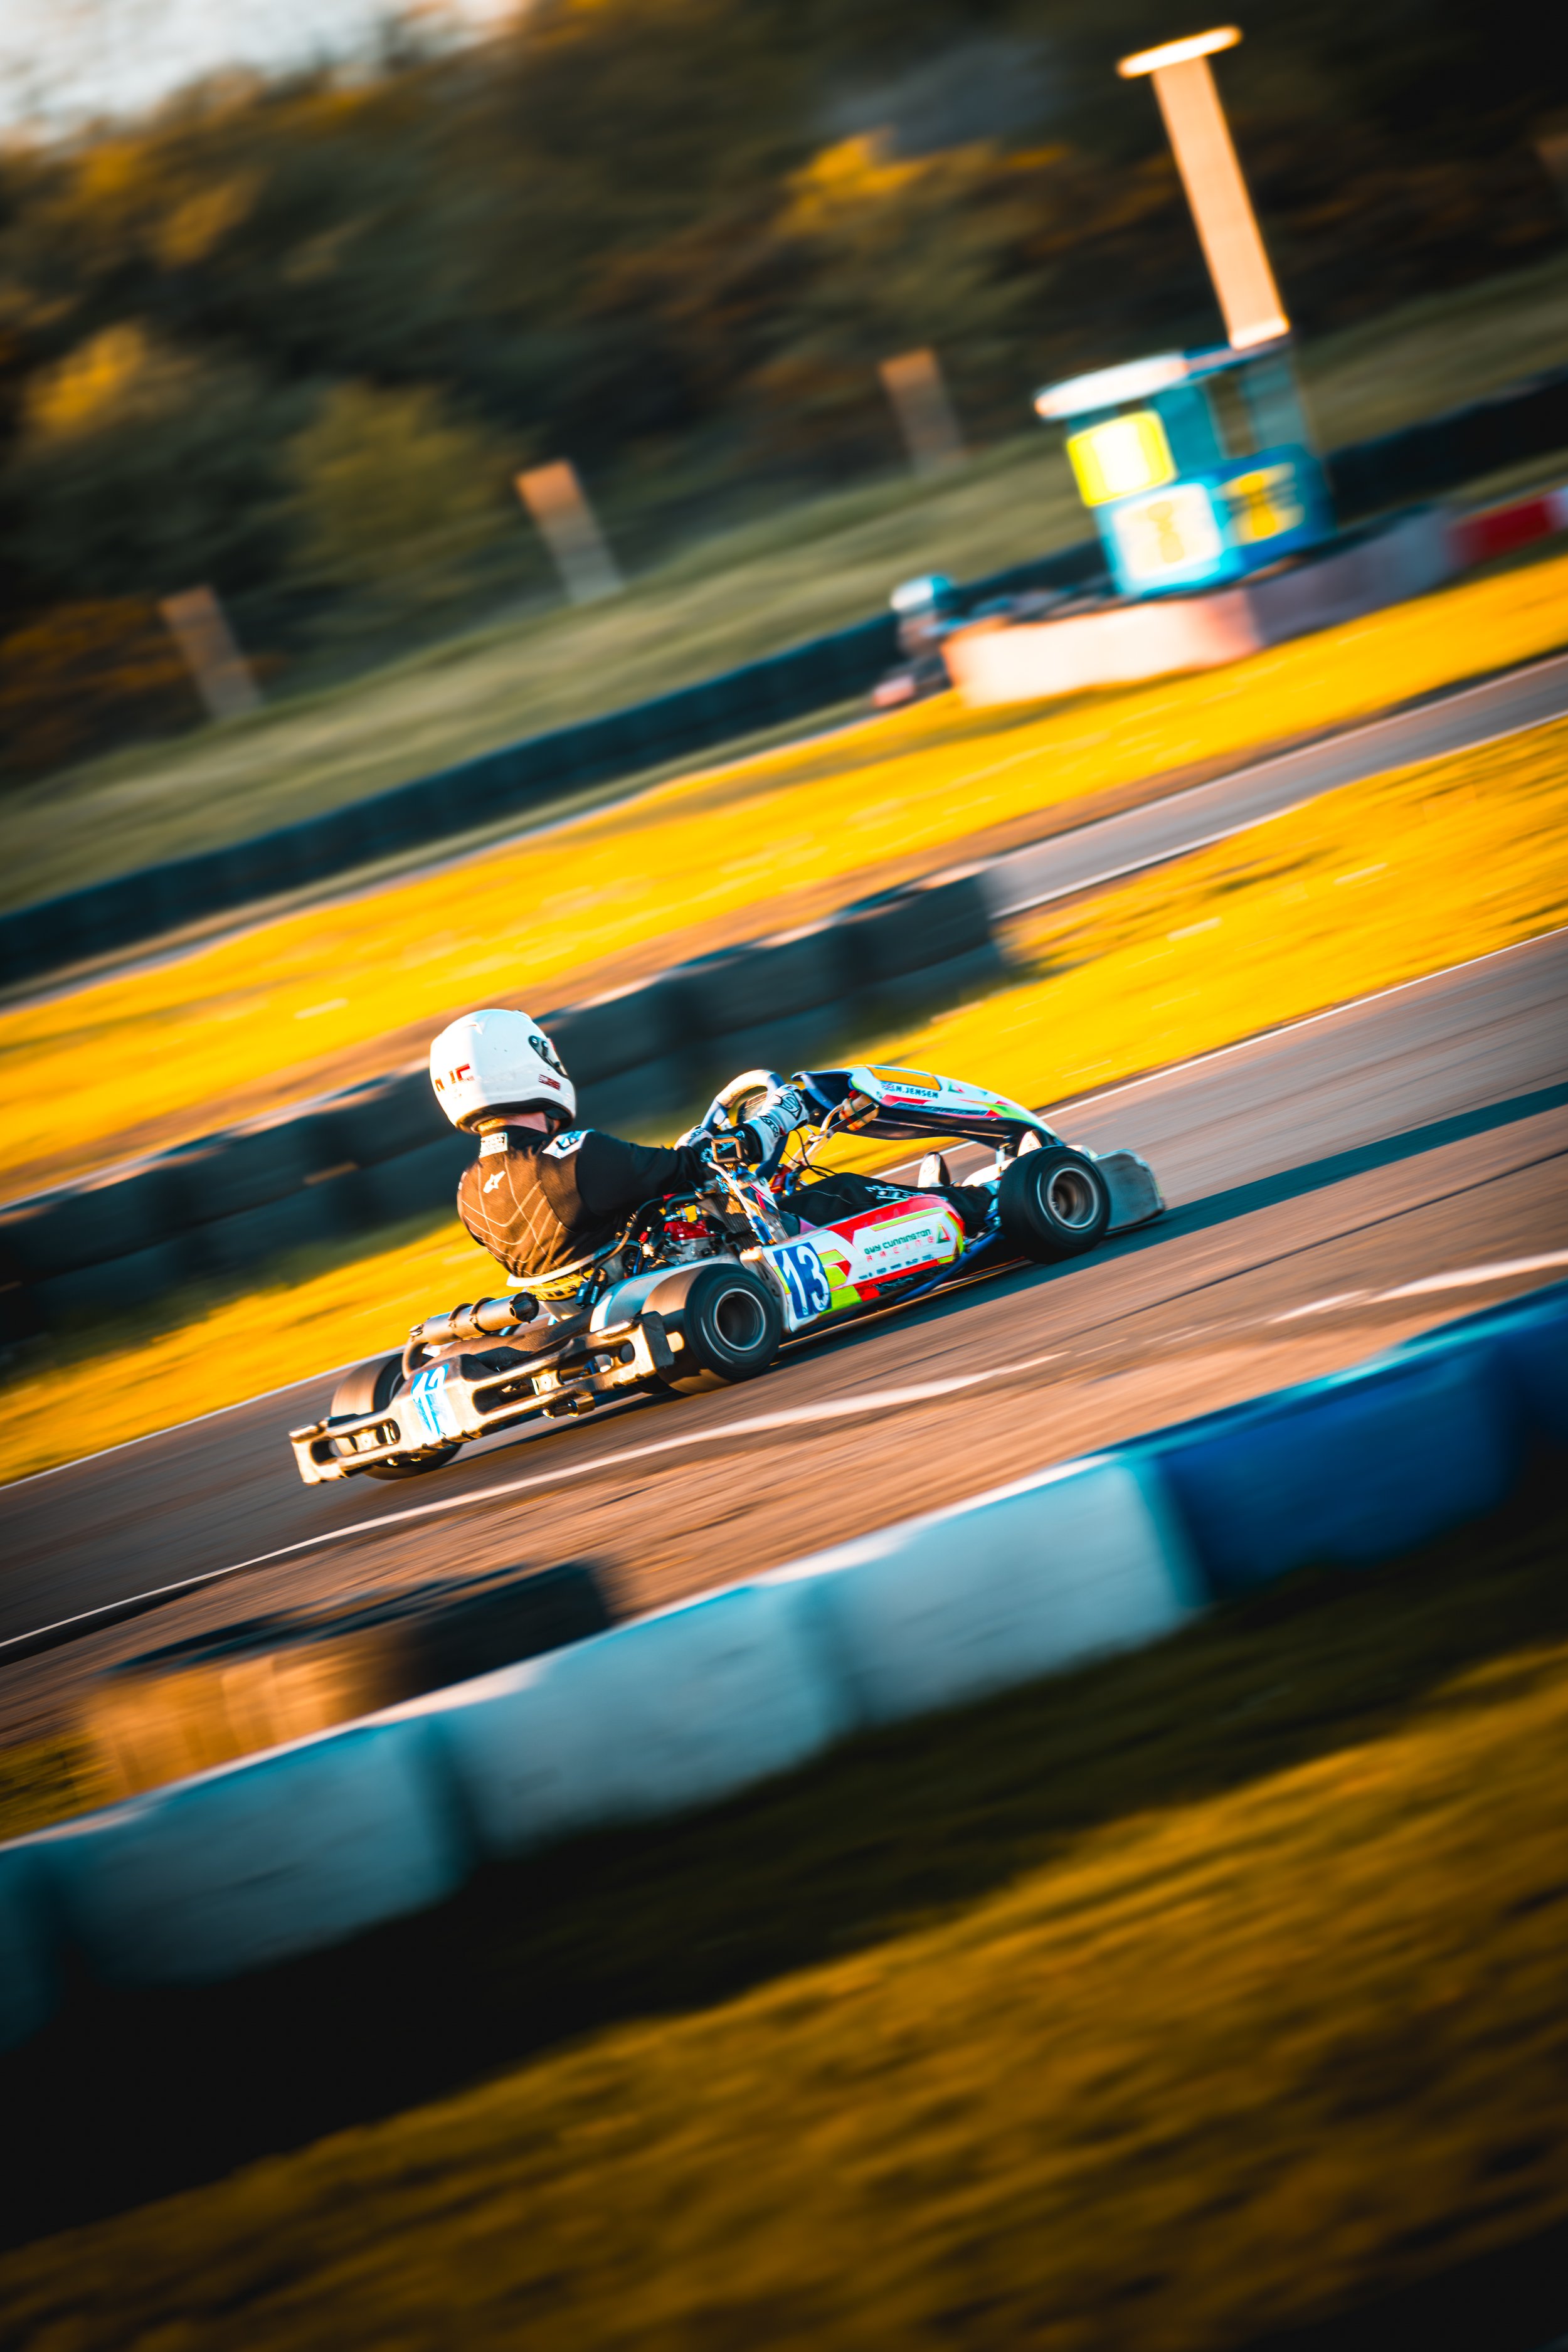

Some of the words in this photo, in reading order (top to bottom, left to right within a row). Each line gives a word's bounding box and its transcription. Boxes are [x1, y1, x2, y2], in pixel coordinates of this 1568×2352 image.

[864, 1244, 881, 1255] GUY
[882, 1229, 932, 1249] CUNNINGTON
[866, 1236, 935, 1263] RACING
[781, 1245, 830, 1316] 13
